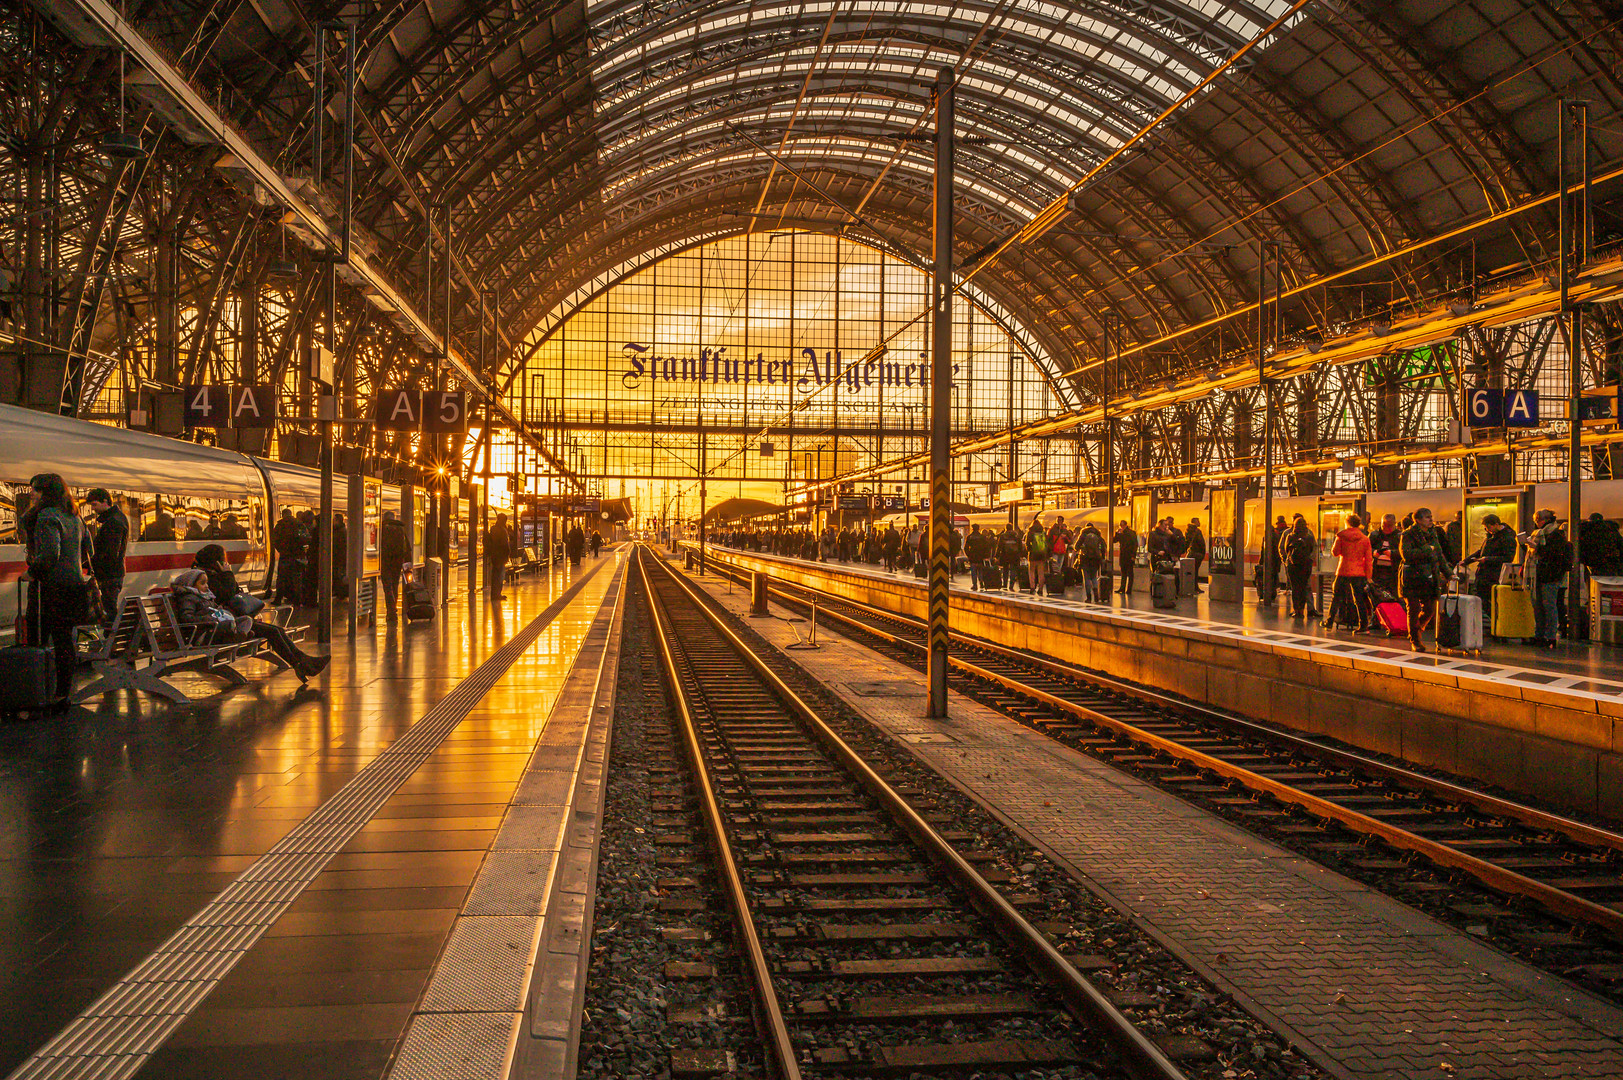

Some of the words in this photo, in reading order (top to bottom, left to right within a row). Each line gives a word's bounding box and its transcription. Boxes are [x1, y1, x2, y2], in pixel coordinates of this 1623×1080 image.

[622, 342, 793, 390] Frankfurter
[190, 387, 212, 418] 4
[234, 387, 260, 418] A
[389, 391, 415, 422] A
[439, 392, 460, 423] 5
[660, 397, 741, 411] ZEITUNG
[751, 396, 785, 412] FÜR
[1471, 389, 1490, 418] 6
[1508, 391, 1530, 419] A
[874, 497, 881, 507] 6
[885, 498, 893, 507] B
[1212, 546, 1233, 560] POLO
